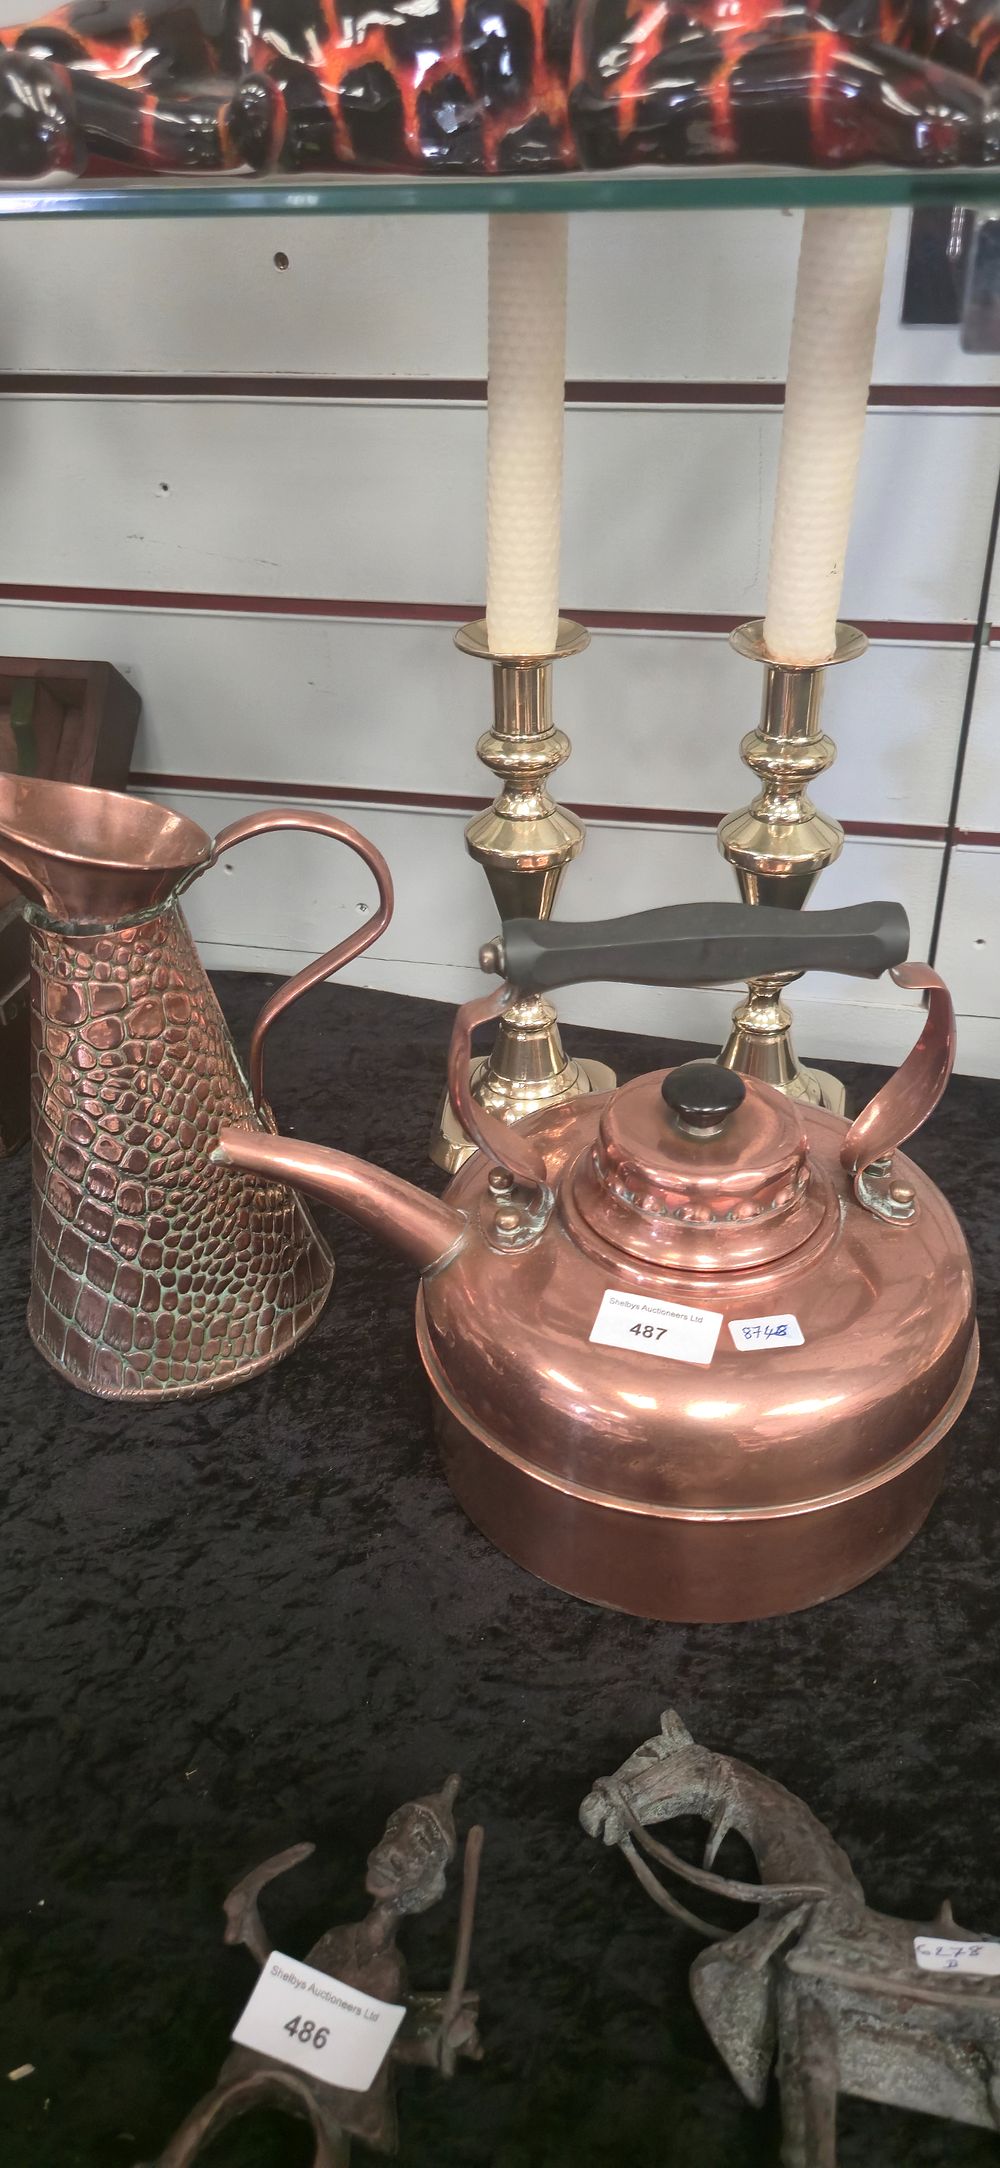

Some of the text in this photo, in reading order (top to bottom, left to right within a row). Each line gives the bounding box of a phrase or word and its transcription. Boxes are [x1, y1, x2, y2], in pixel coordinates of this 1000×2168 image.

[609, 1297, 704, 1324] Shelbys Auctioneers Ltd
[629, 1322, 668, 1341] 487
[270, 1965, 380, 2023] Shelbys Auctioneers Ltd
[284, 2014, 331, 2049] 486
